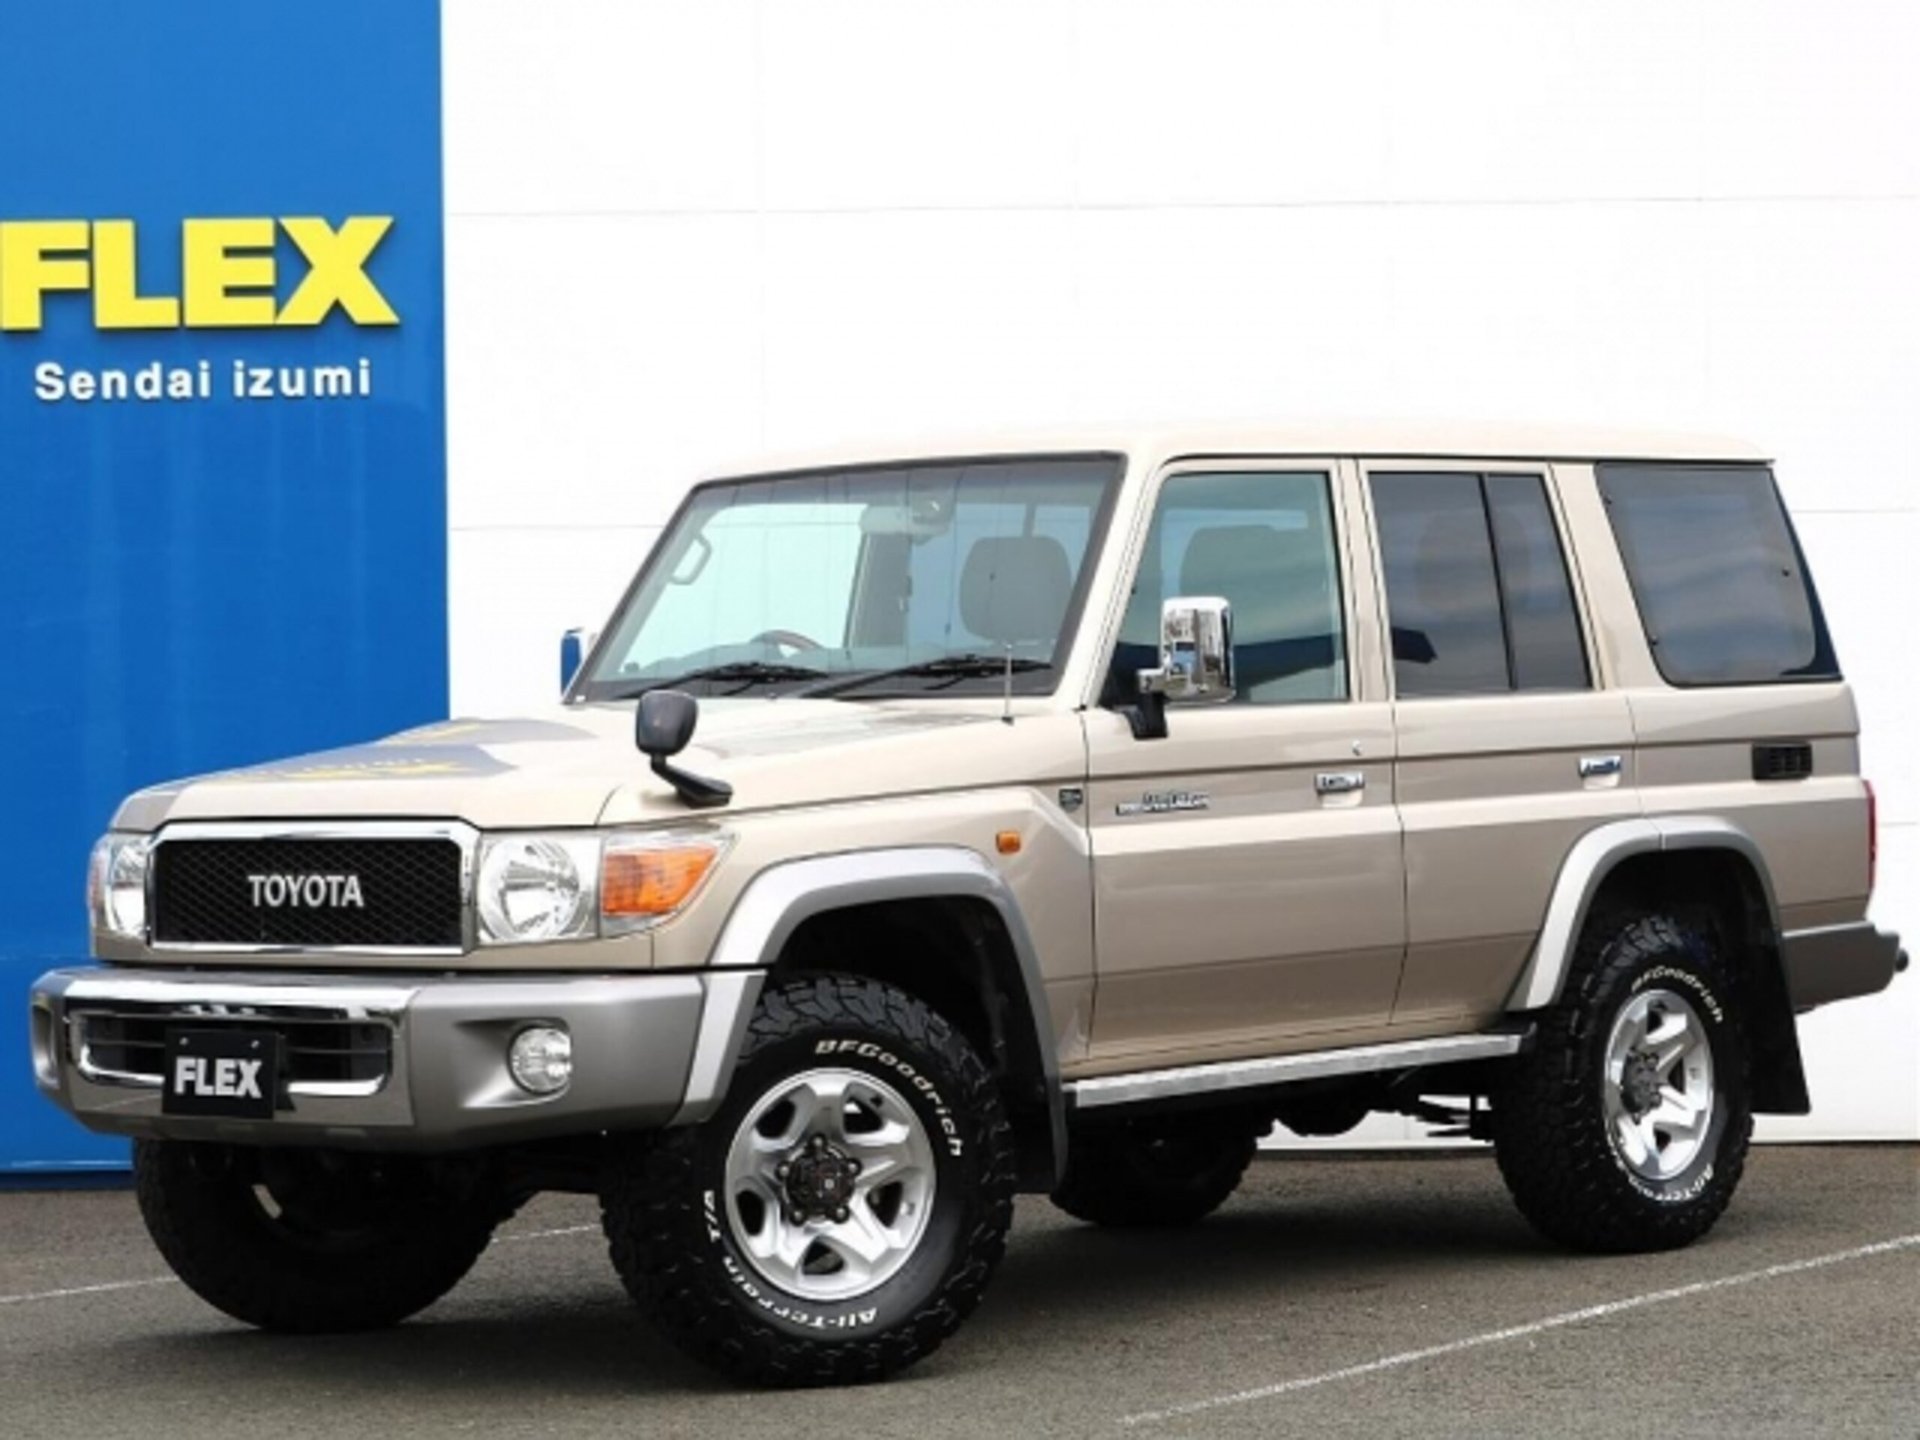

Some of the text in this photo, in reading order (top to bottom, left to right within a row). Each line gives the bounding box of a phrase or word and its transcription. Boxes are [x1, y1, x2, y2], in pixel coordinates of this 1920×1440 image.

[0, 216, 400, 330] FLEX
[34, 358, 371, 400] Sendai izumi
[248, 874, 365, 908] TOYOTA
[174, 1055, 263, 1099] FLEX
[814, 1039, 962, 1157] BFGoodrich
[703, 1190, 878, 1329] All-Terrain T/A
